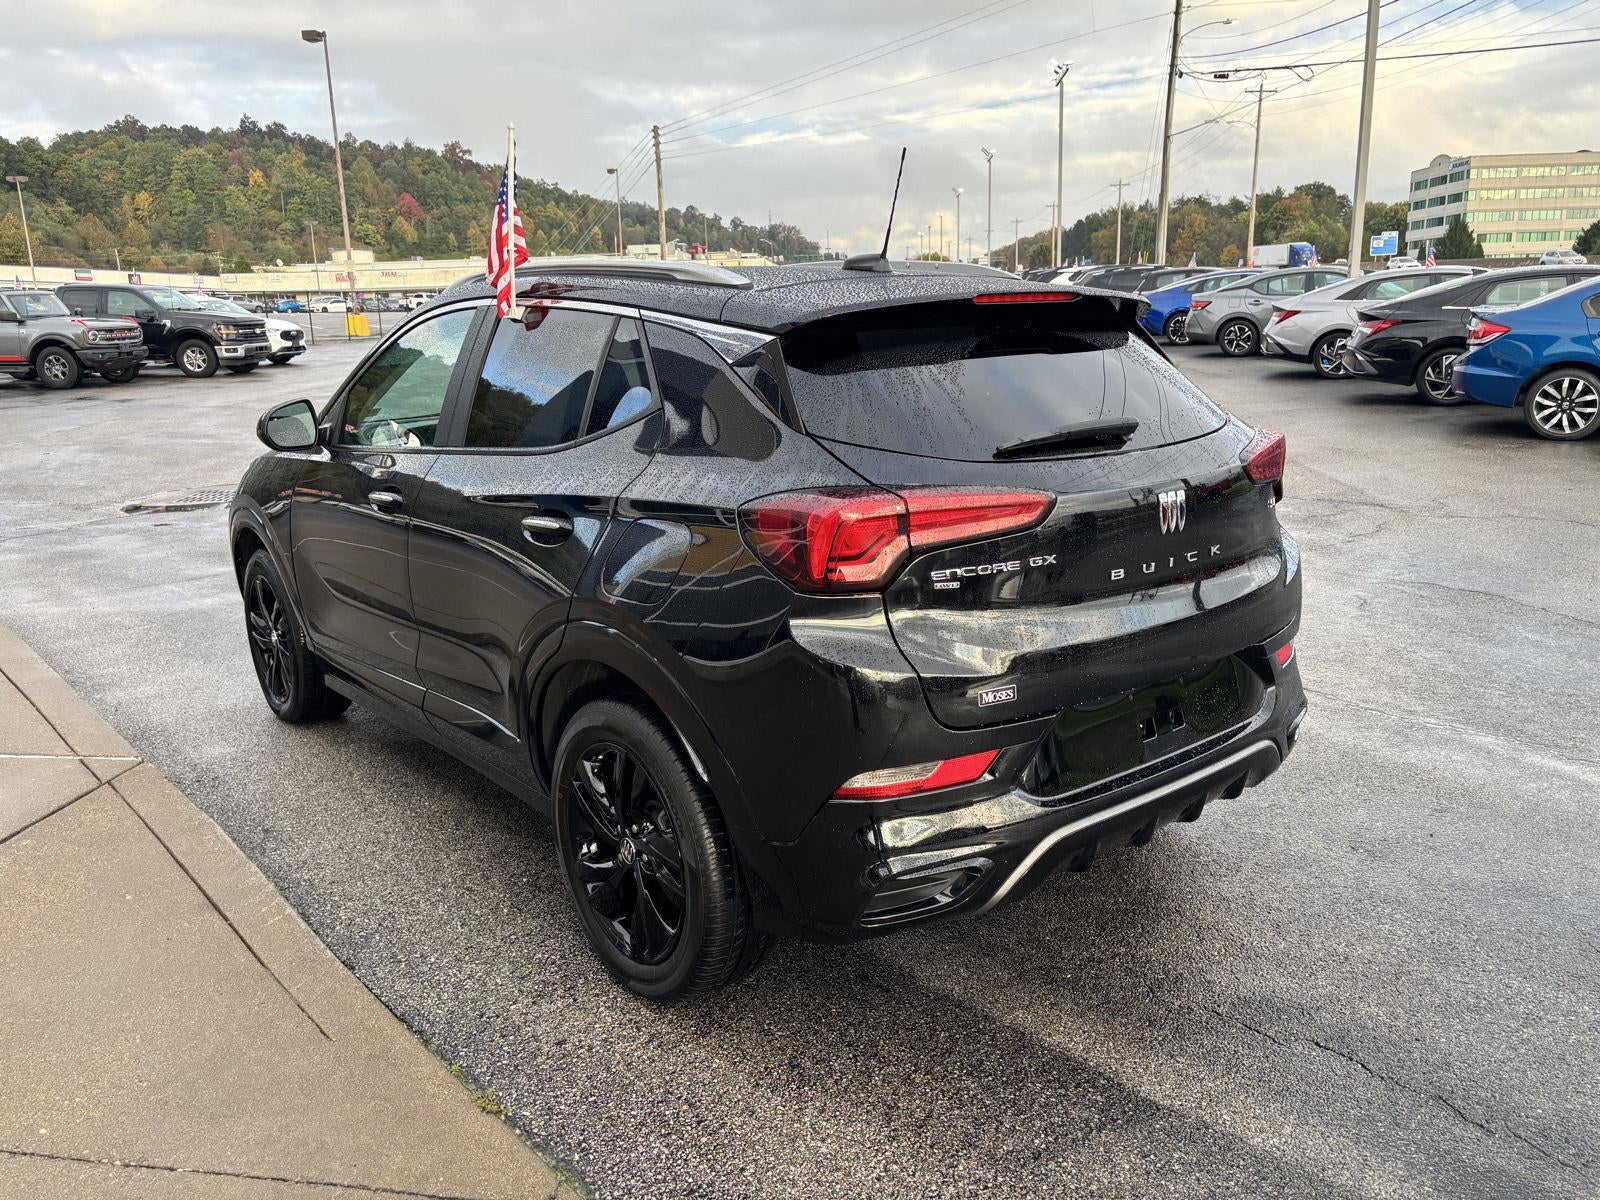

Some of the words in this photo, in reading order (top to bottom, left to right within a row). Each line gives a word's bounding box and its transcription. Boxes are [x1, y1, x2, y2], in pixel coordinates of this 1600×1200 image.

[930, 560, 1021, 581] ENCORE
[1029, 554, 1057, 567] GX
[1110, 544, 1221, 581] BUICK
[981, 689, 1014, 704] MOSES
